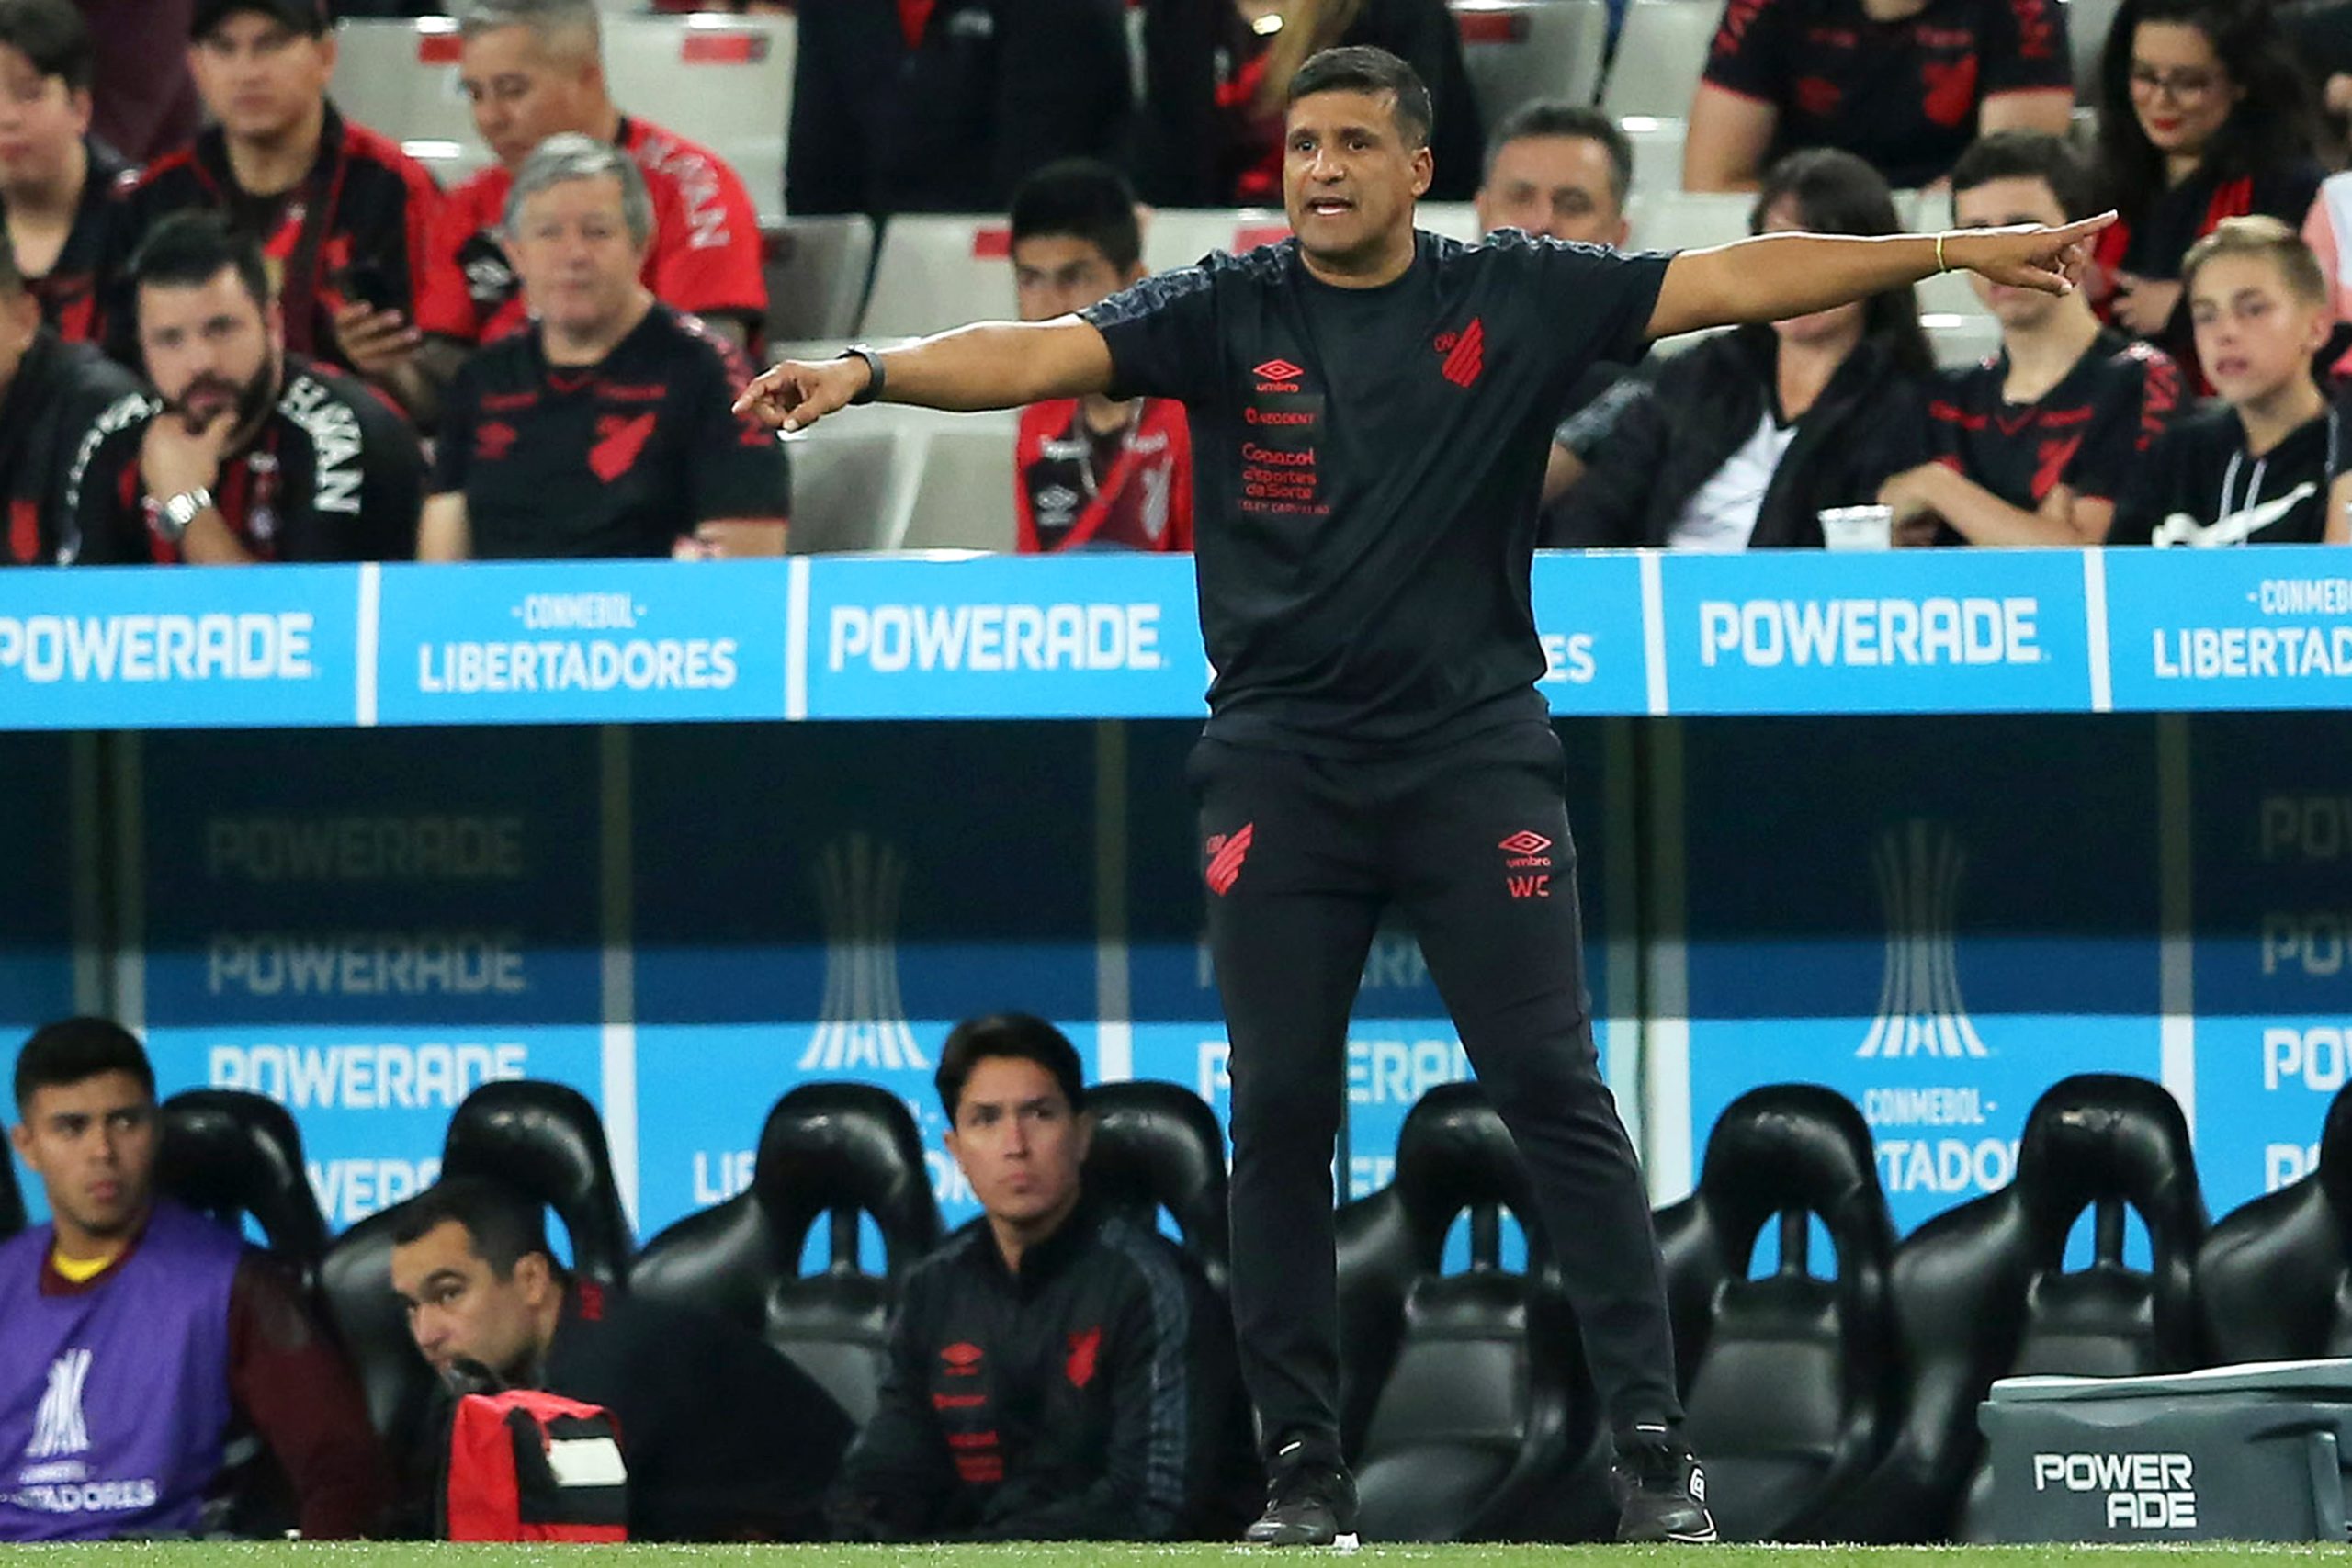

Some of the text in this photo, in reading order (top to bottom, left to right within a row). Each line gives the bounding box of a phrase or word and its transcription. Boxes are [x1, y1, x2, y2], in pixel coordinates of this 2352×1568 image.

[1255, 382, 1300, 393] umbro
[0, 613, 314, 682] POWERADE
[830, 603, 1163, 672] POWERADE
[1699, 596, 2042, 668] POWERADE
[418, 638, 739, 693] LIBERTADORES
[206, 815, 526, 880] POWERADE
[1506, 856, 1552, 868] umbro
[1507, 874, 1550, 897] WC
[209, 931, 529, 994] POWERADE
[2034, 1454, 2193, 1491] POWER
[2107, 1492, 2197, 1529] ADE
